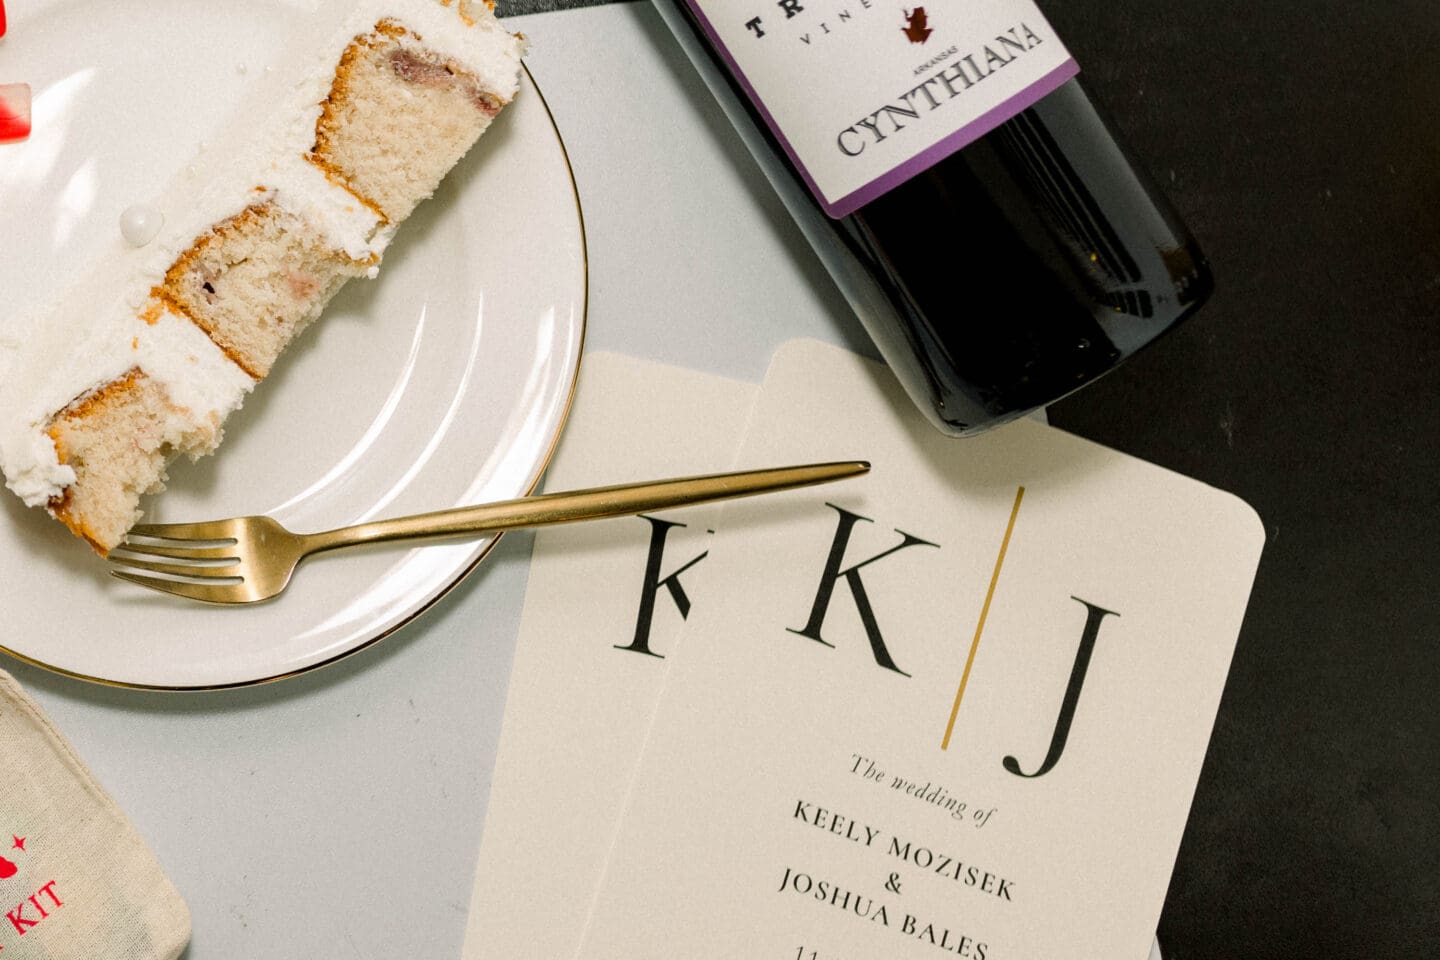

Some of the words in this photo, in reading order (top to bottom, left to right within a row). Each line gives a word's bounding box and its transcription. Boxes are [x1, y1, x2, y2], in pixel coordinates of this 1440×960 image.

[837, 22, 1044, 158] CYNTHIANA
[913, 45, 959, 76] ARKANSAS
[785, 502, 941, 678] K
[1002, 595, 1121, 779] J
[850, 753, 886, 787] The
[891, 778, 968, 821] wedding
[973, 807, 999, 829] of
[793, 800, 881, 848] KEELY
[887, 836, 1017, 902] MOZISEK
[884, 872, 904, 895] &
[6, 878, 66, 936] KIT
[777, 868, 891, 927] JOSHUA
[901, 914, 989, 960] BALES
